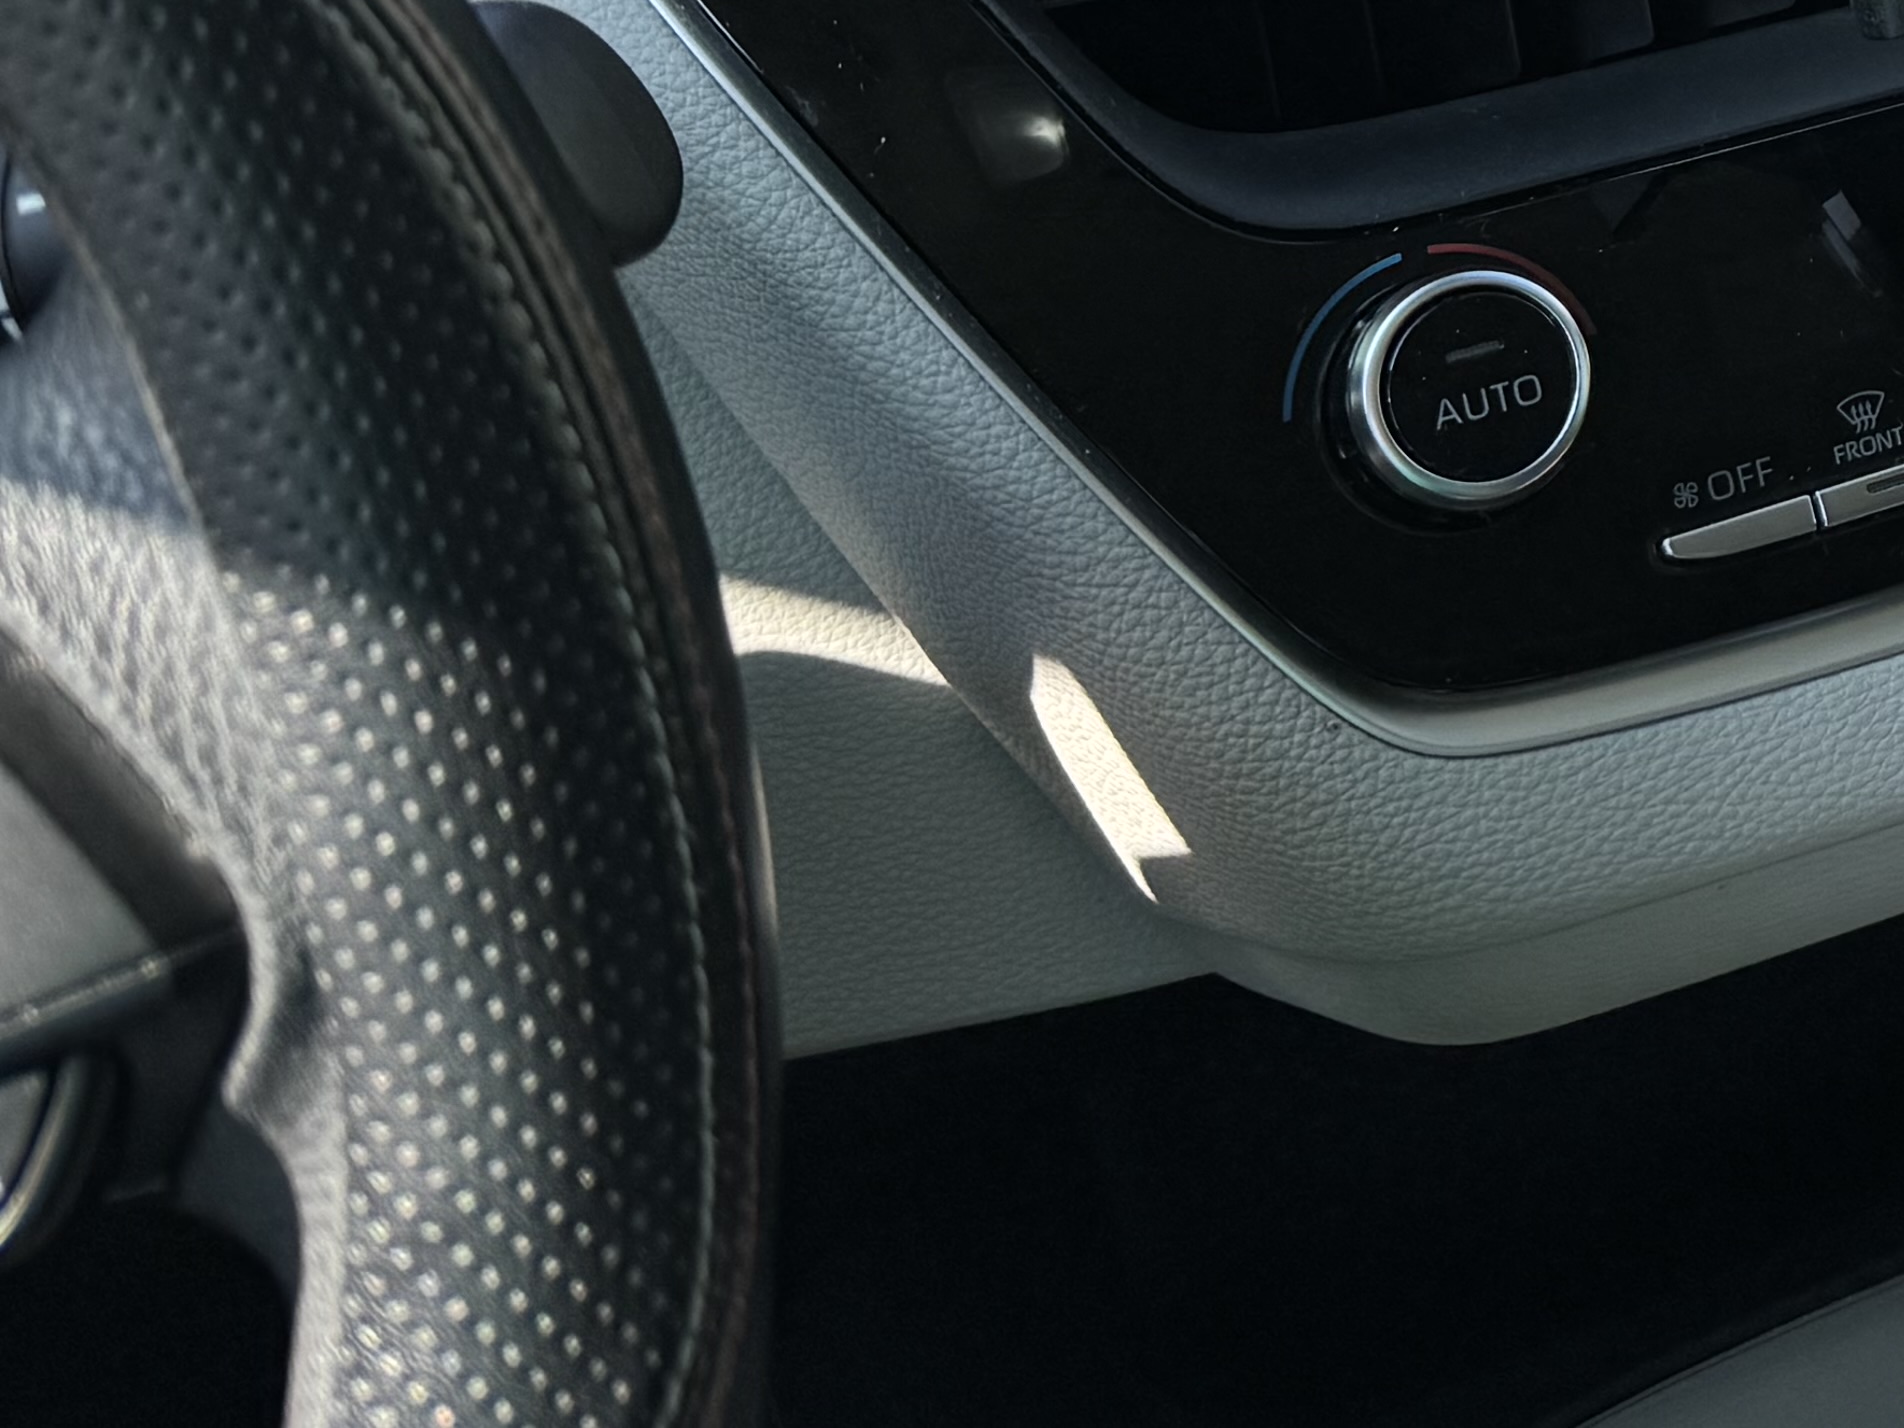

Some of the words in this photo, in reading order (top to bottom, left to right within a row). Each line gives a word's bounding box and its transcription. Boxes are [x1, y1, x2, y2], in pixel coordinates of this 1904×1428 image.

[1436, 374, 1543, 430] AUTO
[1833, 425, 1903, 464] FRONT
[1707, 457, 1774, 501] OFF
